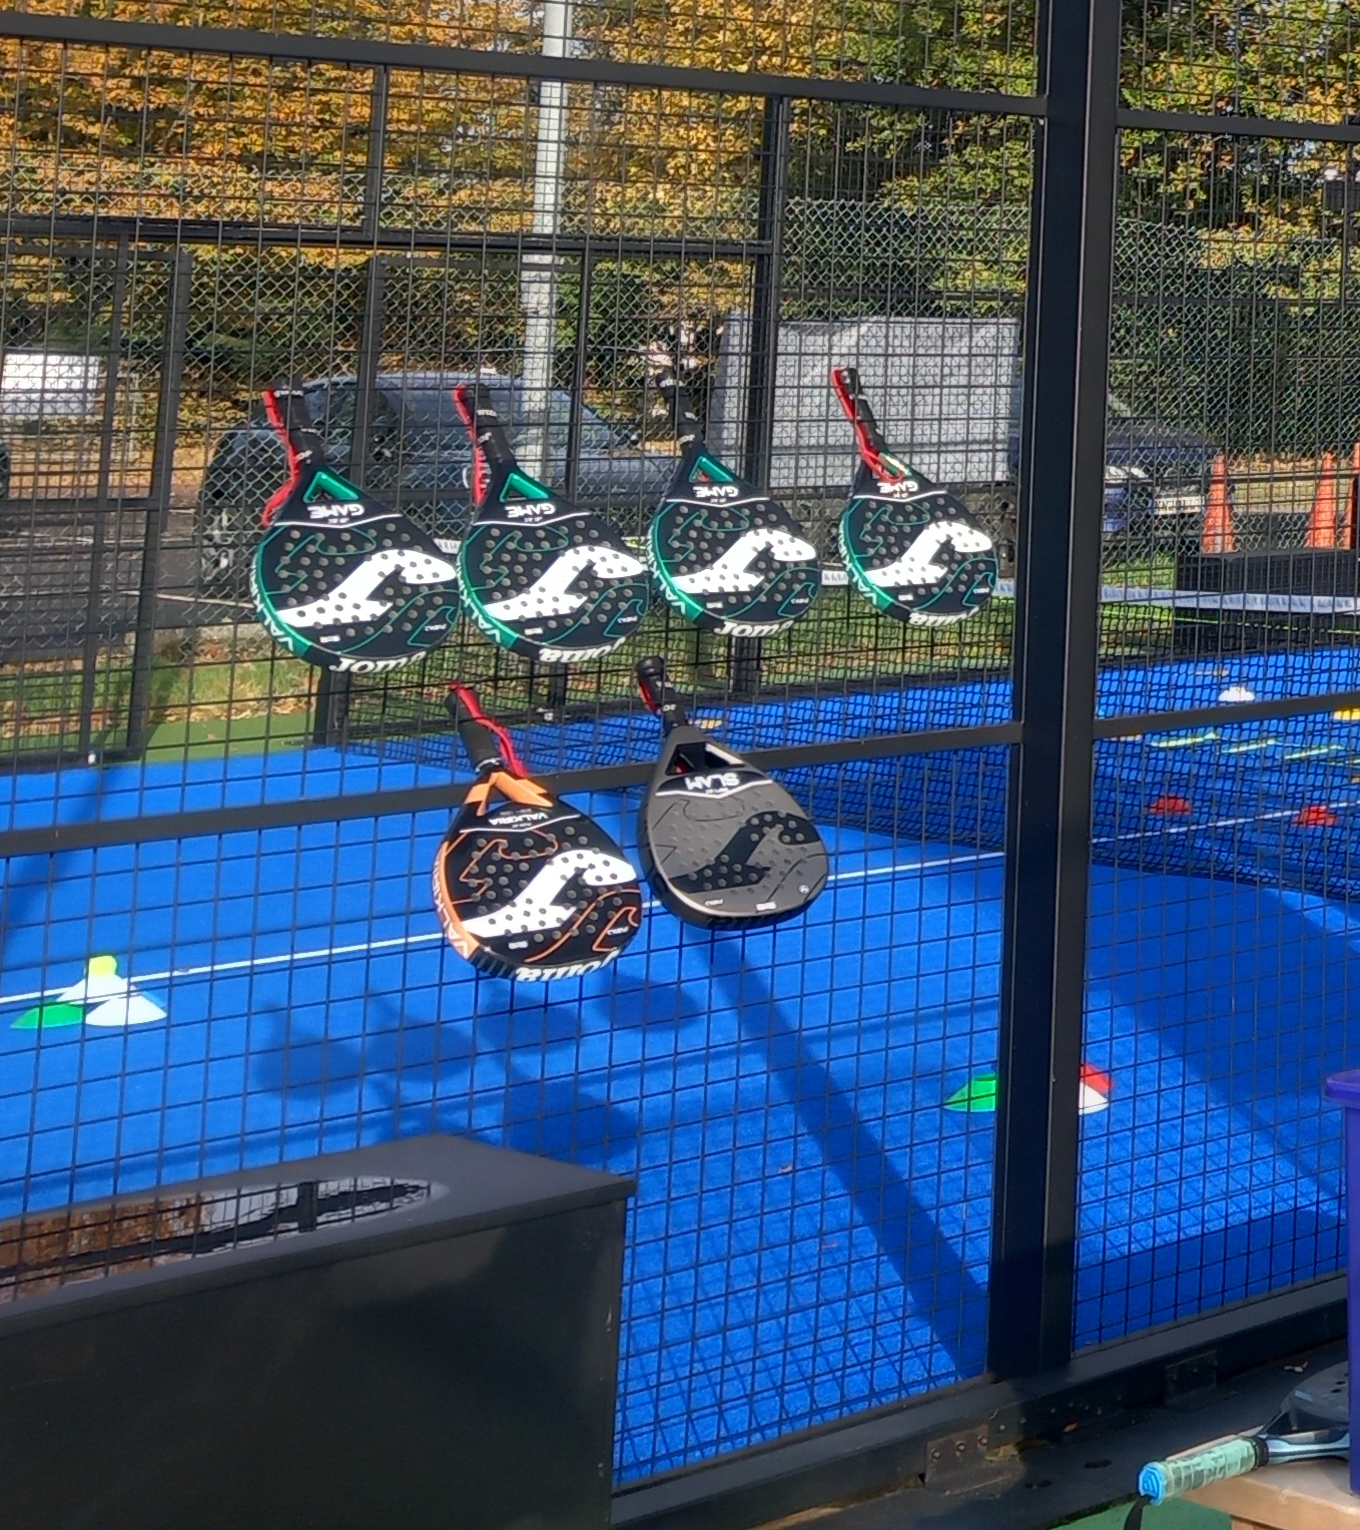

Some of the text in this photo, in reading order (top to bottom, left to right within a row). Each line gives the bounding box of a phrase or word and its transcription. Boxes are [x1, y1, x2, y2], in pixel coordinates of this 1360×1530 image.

[693, 485, 738, 498] GAME
[877, 480, 918, 494] GAME
[307, 503, 366, 520] GAME
[504, 502, 557, 519] GAME
[684, 773, 740, 790] SLAM
[488, 812, 549, 826] VALKIRIA
